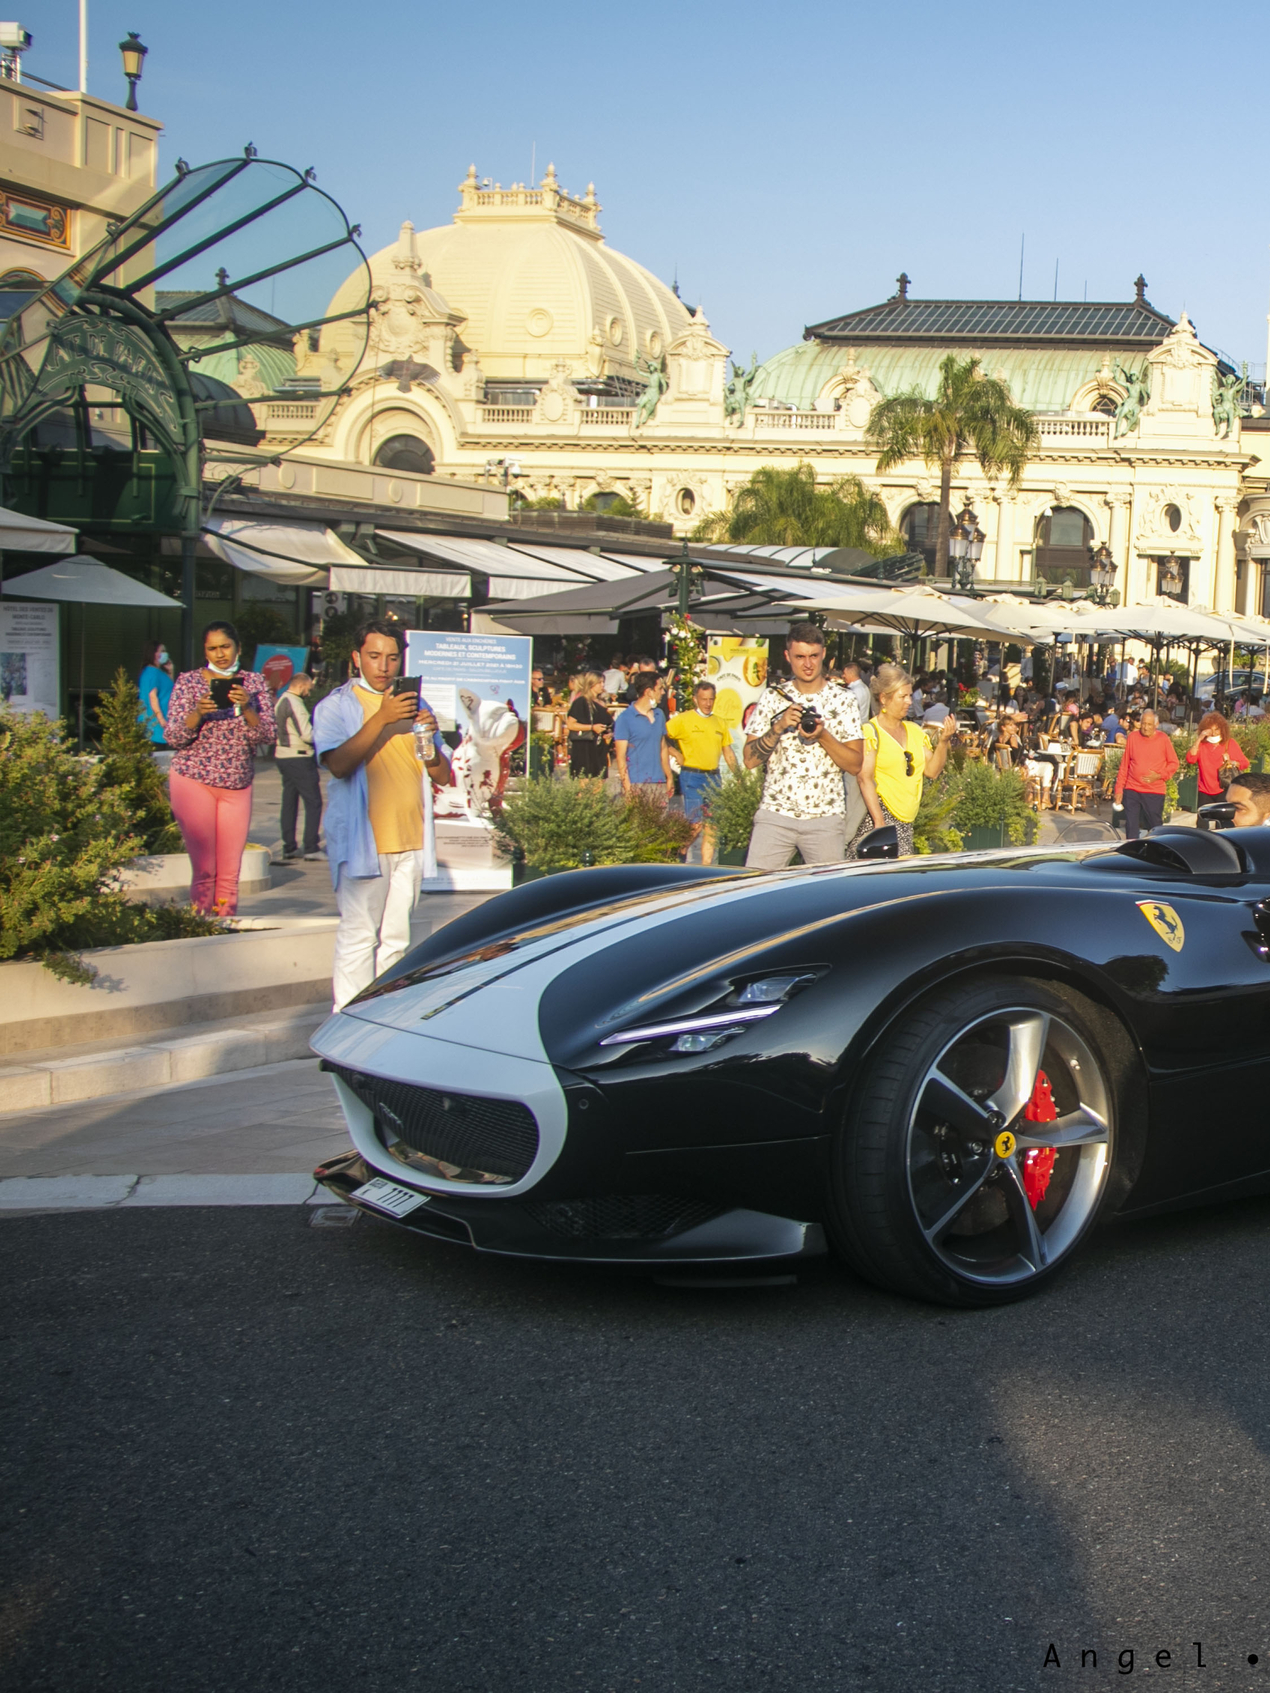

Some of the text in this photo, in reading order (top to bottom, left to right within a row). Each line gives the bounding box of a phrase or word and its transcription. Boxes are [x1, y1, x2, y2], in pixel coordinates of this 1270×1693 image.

[87, 332, 109, 357] DE
[468, 644, 506, 652] SCULPTURES
[466, 651, 516, 660] CONTEMPORAINS
